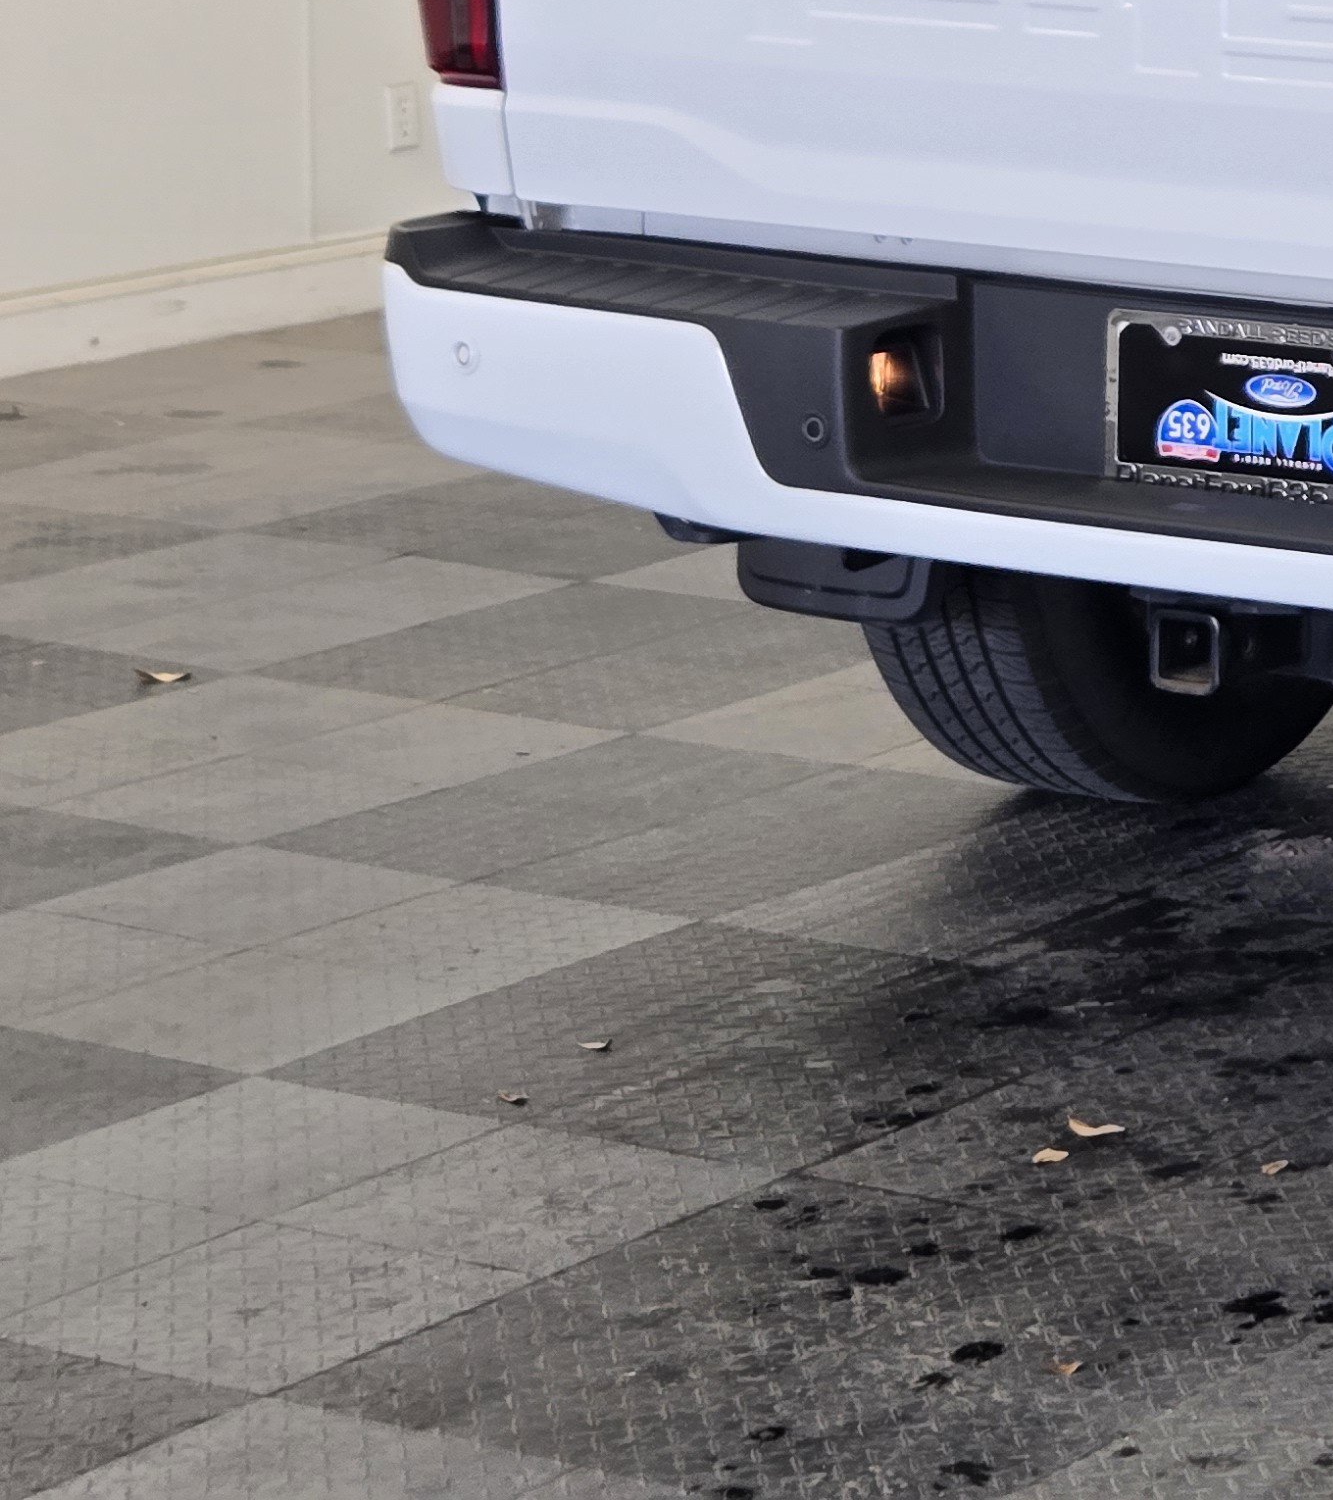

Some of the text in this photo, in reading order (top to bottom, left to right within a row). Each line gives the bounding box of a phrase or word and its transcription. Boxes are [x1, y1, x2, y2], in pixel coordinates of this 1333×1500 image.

[1178, 317, 1268, 341] RANDALL
[1260, 377, 1303, 400] Ford
[1167, 410, 1211, 440] 635
